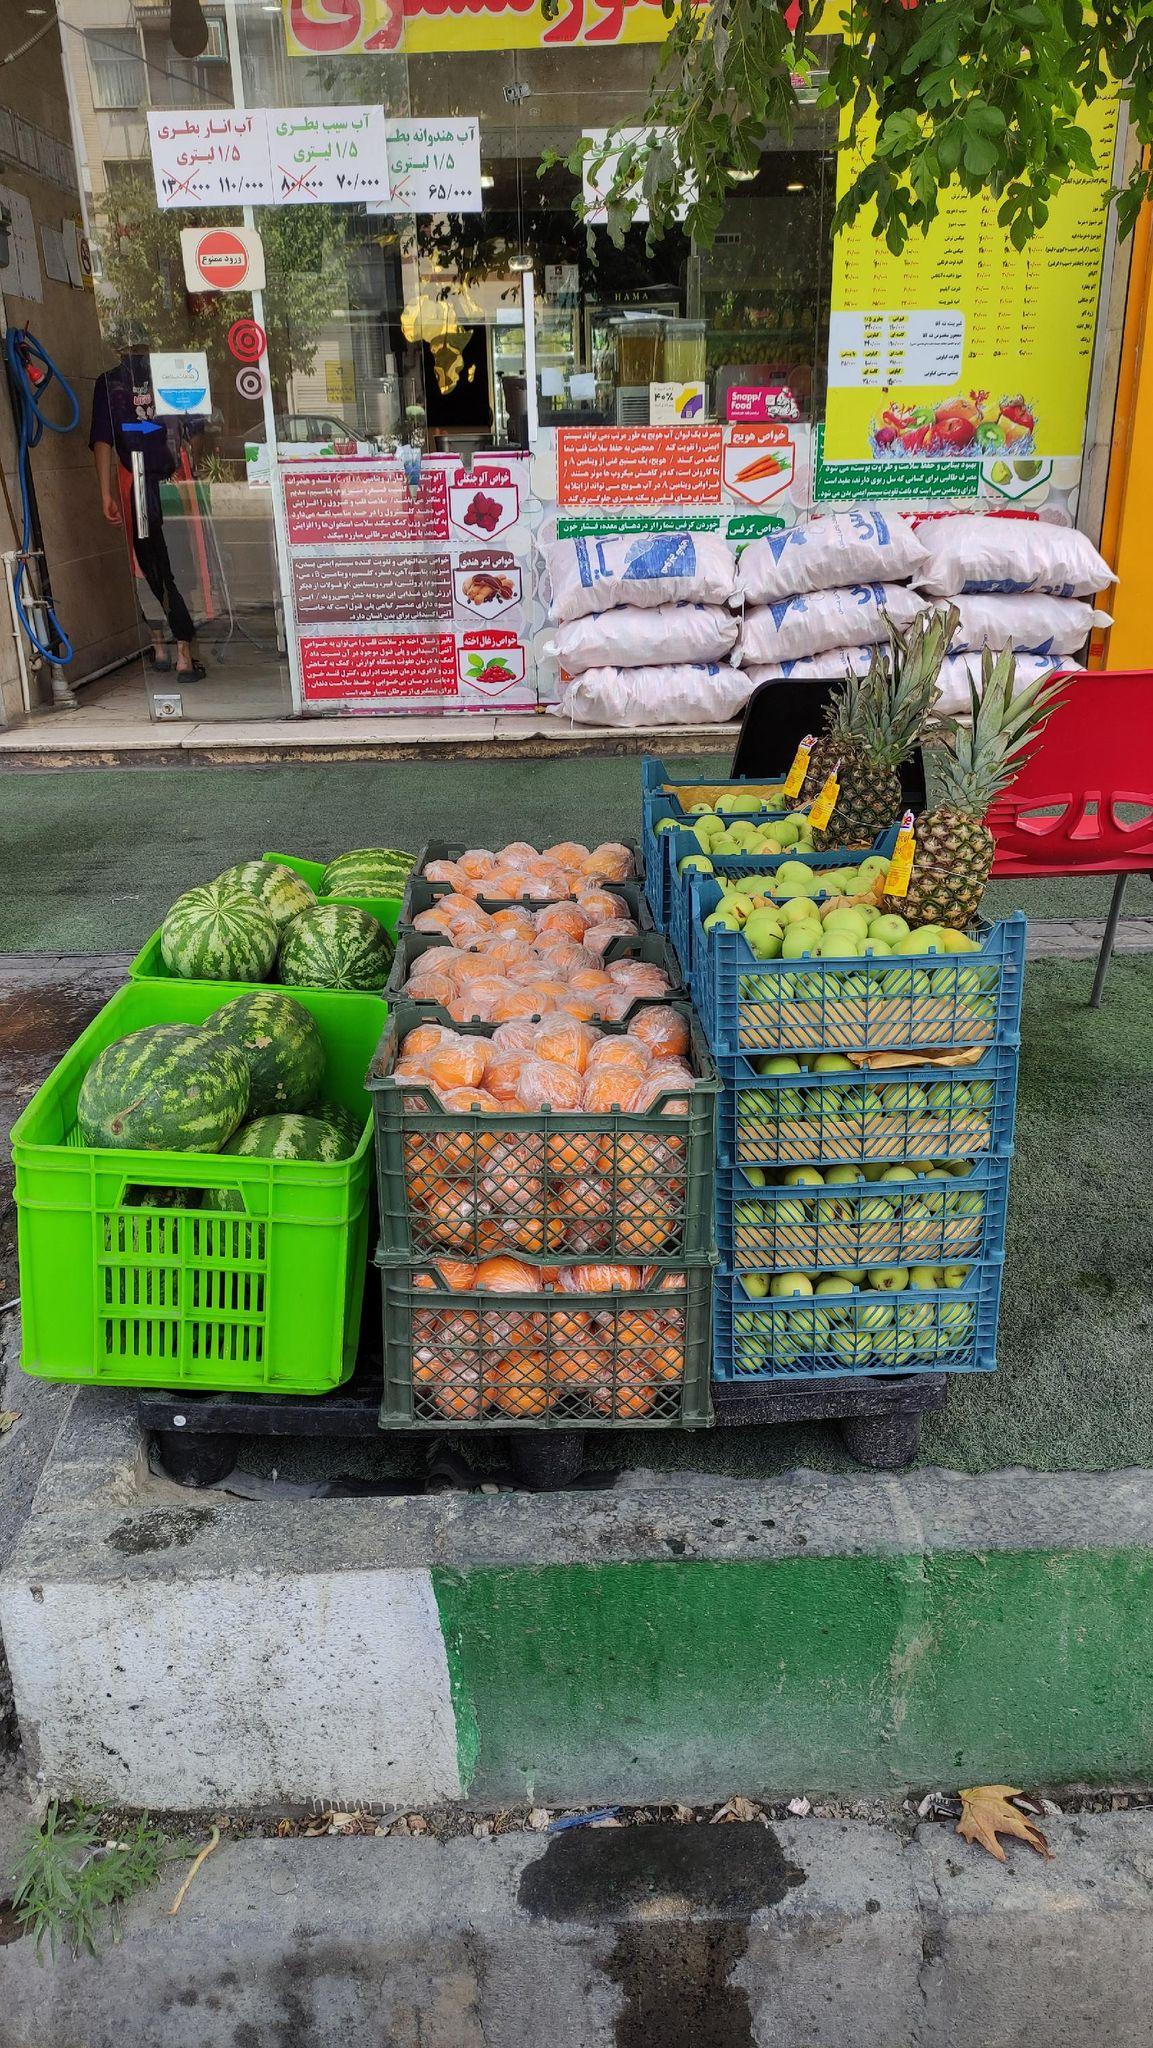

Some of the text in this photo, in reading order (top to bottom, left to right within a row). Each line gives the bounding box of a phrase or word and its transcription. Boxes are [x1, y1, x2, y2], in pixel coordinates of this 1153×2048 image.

[158, 116, 253, 139] آب انار بطری
[277, 113, 370, 136] آب سیب بطری
[386, 126, 475, 147] آب هندوانه بط
[177, 145, 214, 165] لیتری
[294, 142, 332, 163] لیتری
[392, 155, 429, 174] لیتری
[219, 176, 263, 193] ۱۱۰/۰۰۰
[336, 173, 379, 190] ۷۰/۰۰۰
[429, 184, 472, 200] ۶۵/۰۰۰
[202, 255, 242, 265] ورود ممنوع
[615, 292, 648, 301] HAMA
[731, 401, 751, 410] Food
[664, 430, 673, 438] آب
[732, 430, 785, 444] خواص هویج
[490, 471, 509, 486] خواص
[729, 523, 755, 536] کرفس
[460, 558, 479, 569] هندی
[492, 557, 513, 568] خواص
[496, 636, 517, 646] خواص
